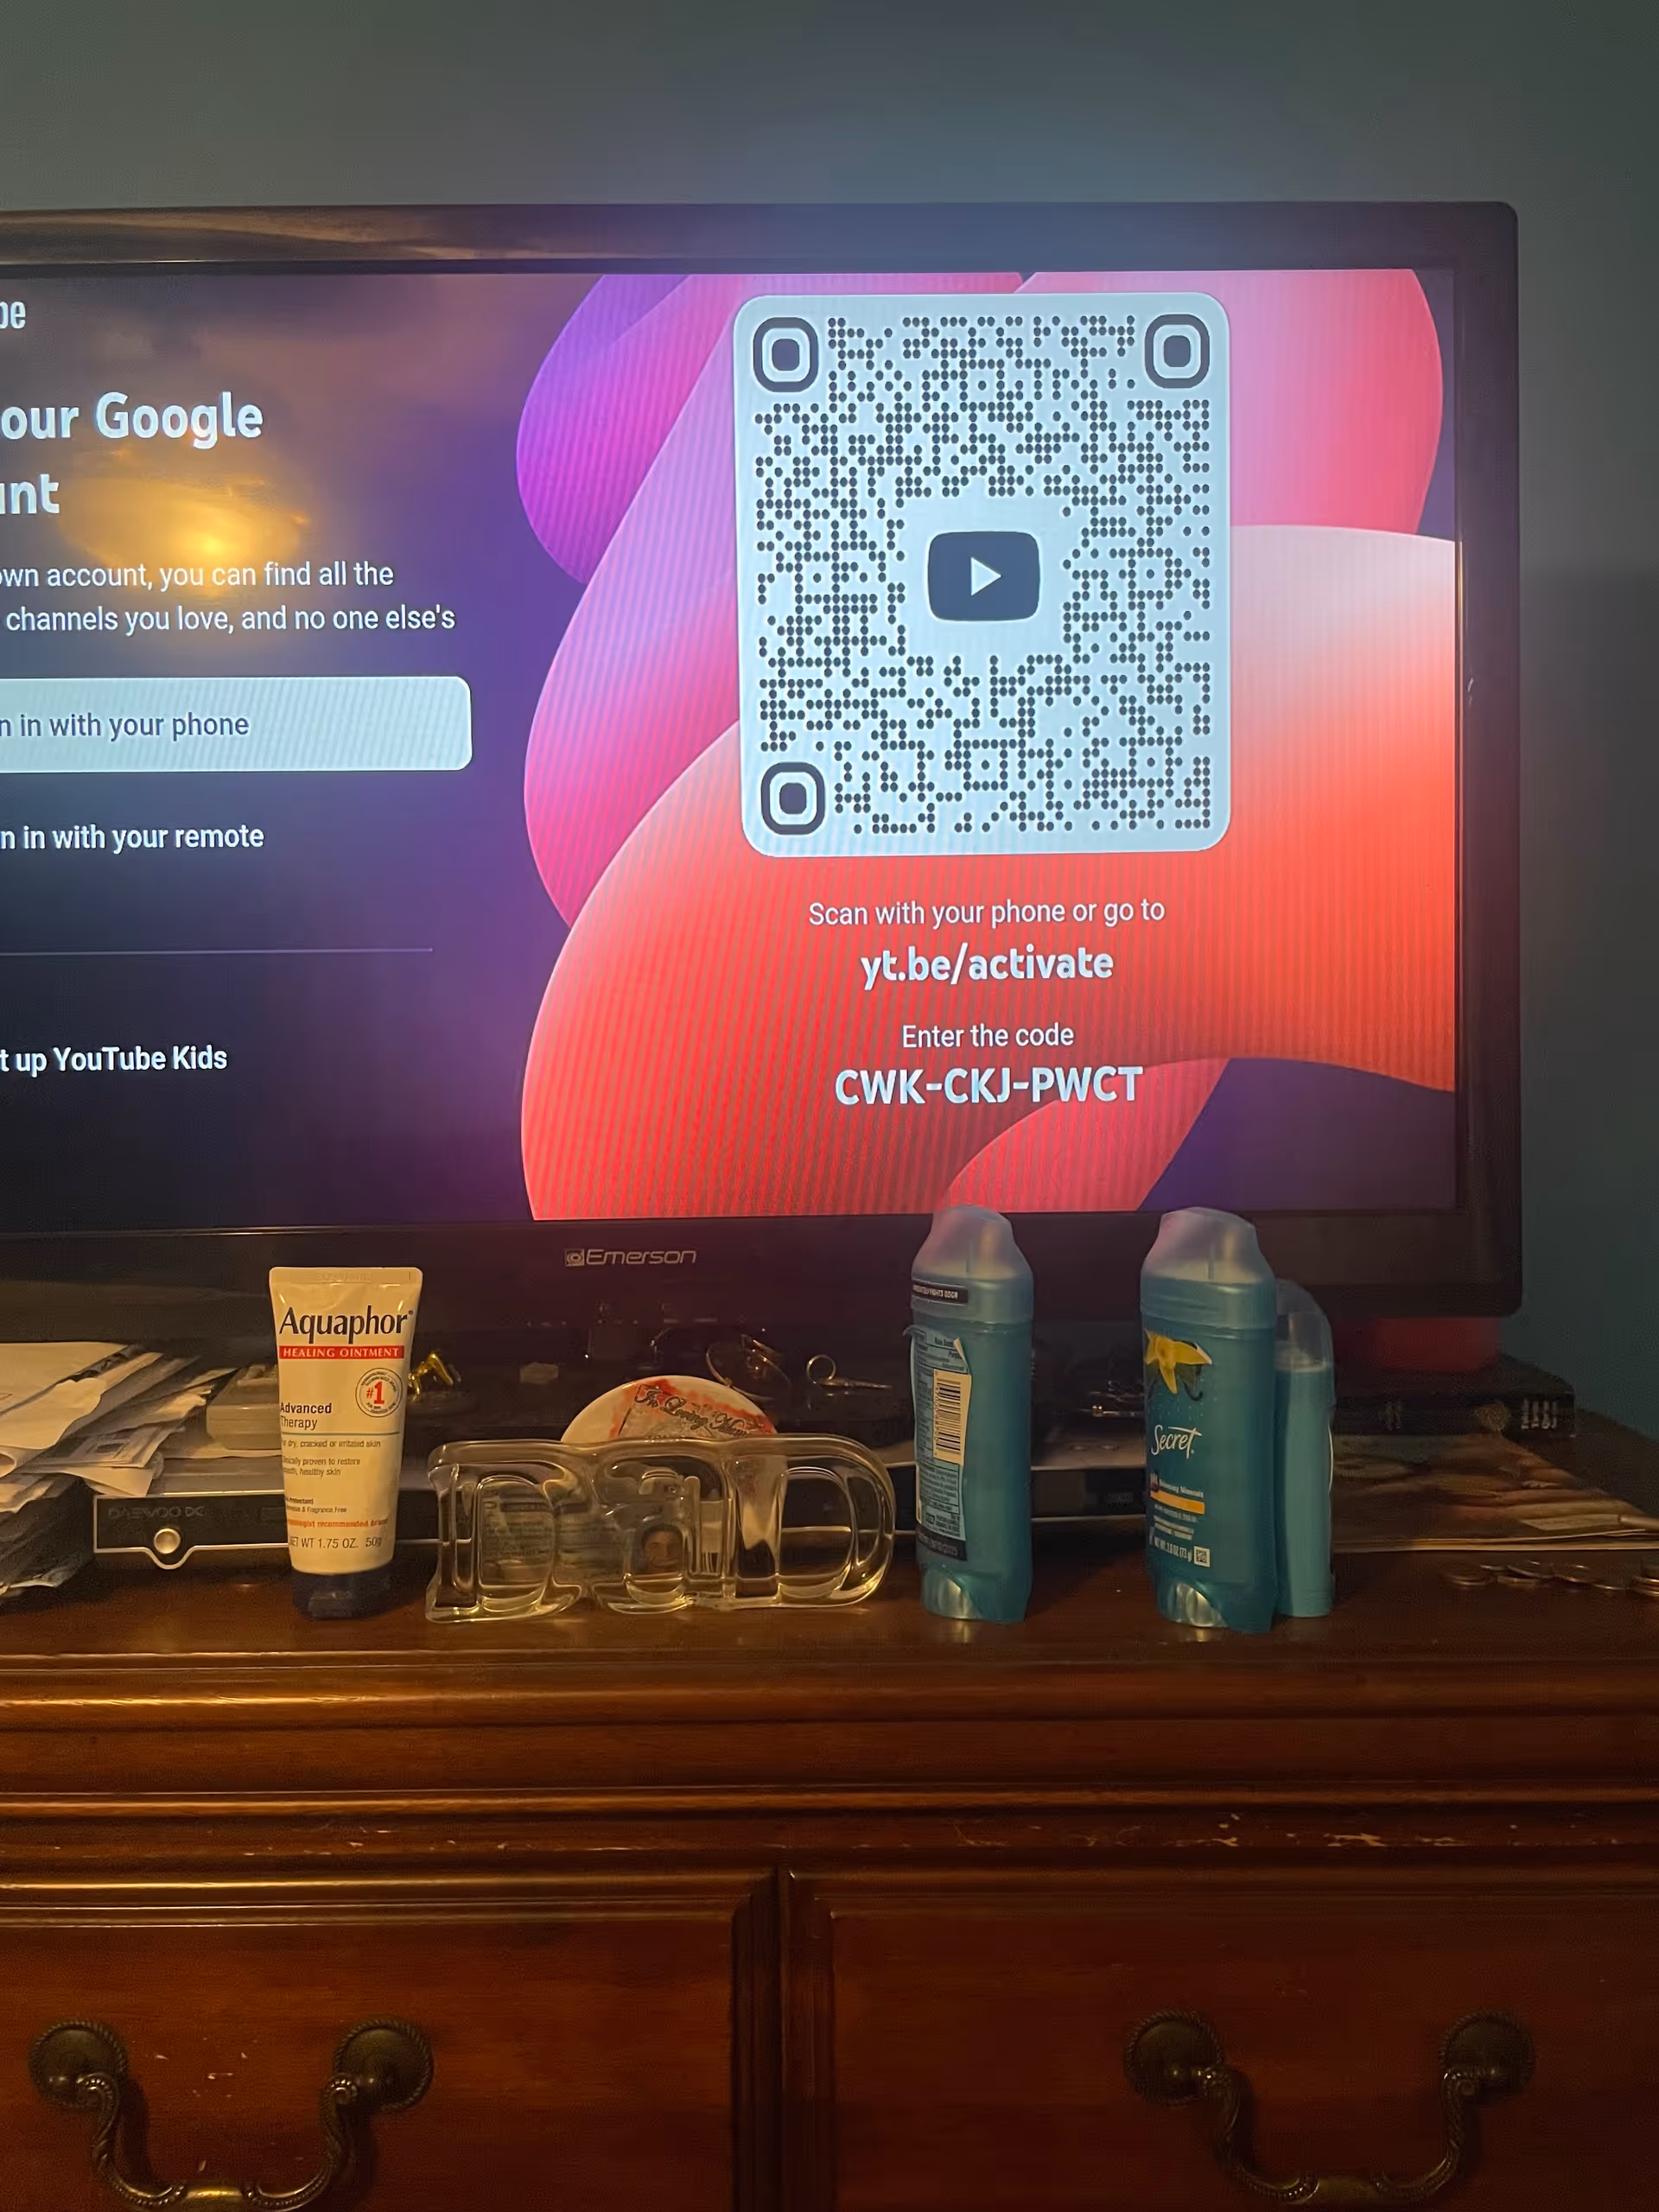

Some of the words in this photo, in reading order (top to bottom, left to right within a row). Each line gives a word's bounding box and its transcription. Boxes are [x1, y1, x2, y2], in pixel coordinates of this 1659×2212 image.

[1, 406, 79, 440] our
[96, 391, 264, 449] Google
[0, 568, 40, 588] wn
[47, 563, 153, 591] account,
[160, 567, 204, 593] you
[212, 566, 257, 587] can
[264, 561, 311, 586] find
[319, 561, 346, 586] all
[353, 561, 394, 586] the
[6, 606, 118, 632] channels
[125, 611, 169, 637] you
[177, 606, 234, 634] love,
[241, 605, 287, 630] and
[295, 610, 325, 630] no
[334, 610, 378, 630] one
[385, 604, 455, 630] else's
[21, 714, 41, 737] in
[49, 712, 101, 737] with
[110, 718, 164, 742] your
[173, 712, 250, 742] phone
[23, 825, 45, 849] in
[52, 824, 105, 849] with
[112, 828, 168, 854] your
[175, 824, 264, 849] remote
[809, 902, 868, 925] Scan
[875, 901, 925, 925] with
[931, 906, 984, 930] your
[991, 899, 1065, 928] phone
[1072, 902, 1097, 922] or
[1103, 902, 1135, 927] go
[1141, 899, 1166, 921] to
[860, 942, 1114, 990] yt.be/activate
[902, 1024, 964, 1048] Enter
[970, 1023, 1008, 1047] the
[1015, 1022, 1074, 1047] code
[16, 1052, 48, 1078] up
[53, 1045, 167, 1072] YouTube
[172, 1044, 228, 1071] Kids
[835, 1065, 1143, 1105] CWK-CKJ-PWCT
[586, 1248, 697, 1265] Emerson
[279, 1306, 408, 1344] Aquaphor
[283, 1347, 335, 1357] HEALING
[340, 1347, 400, 1357] OINTMENT
[280, 1402, 332, 1414] Advanced
[366, 1381, 385, 1405] #1
[281, 1415, 318, 1430] Therapy
[365, 1440, 381, 1448] skin
[1151, 1424, 1203, 1459] Secret
[300, 1468, 325, 1478] healthy
[302, 1458, 327, 1466] proven
[338, 1458, 361, 1466] restore
[301, 1537, 315, 1548] WT
[318, 1538, 339, 1549] 1.75
